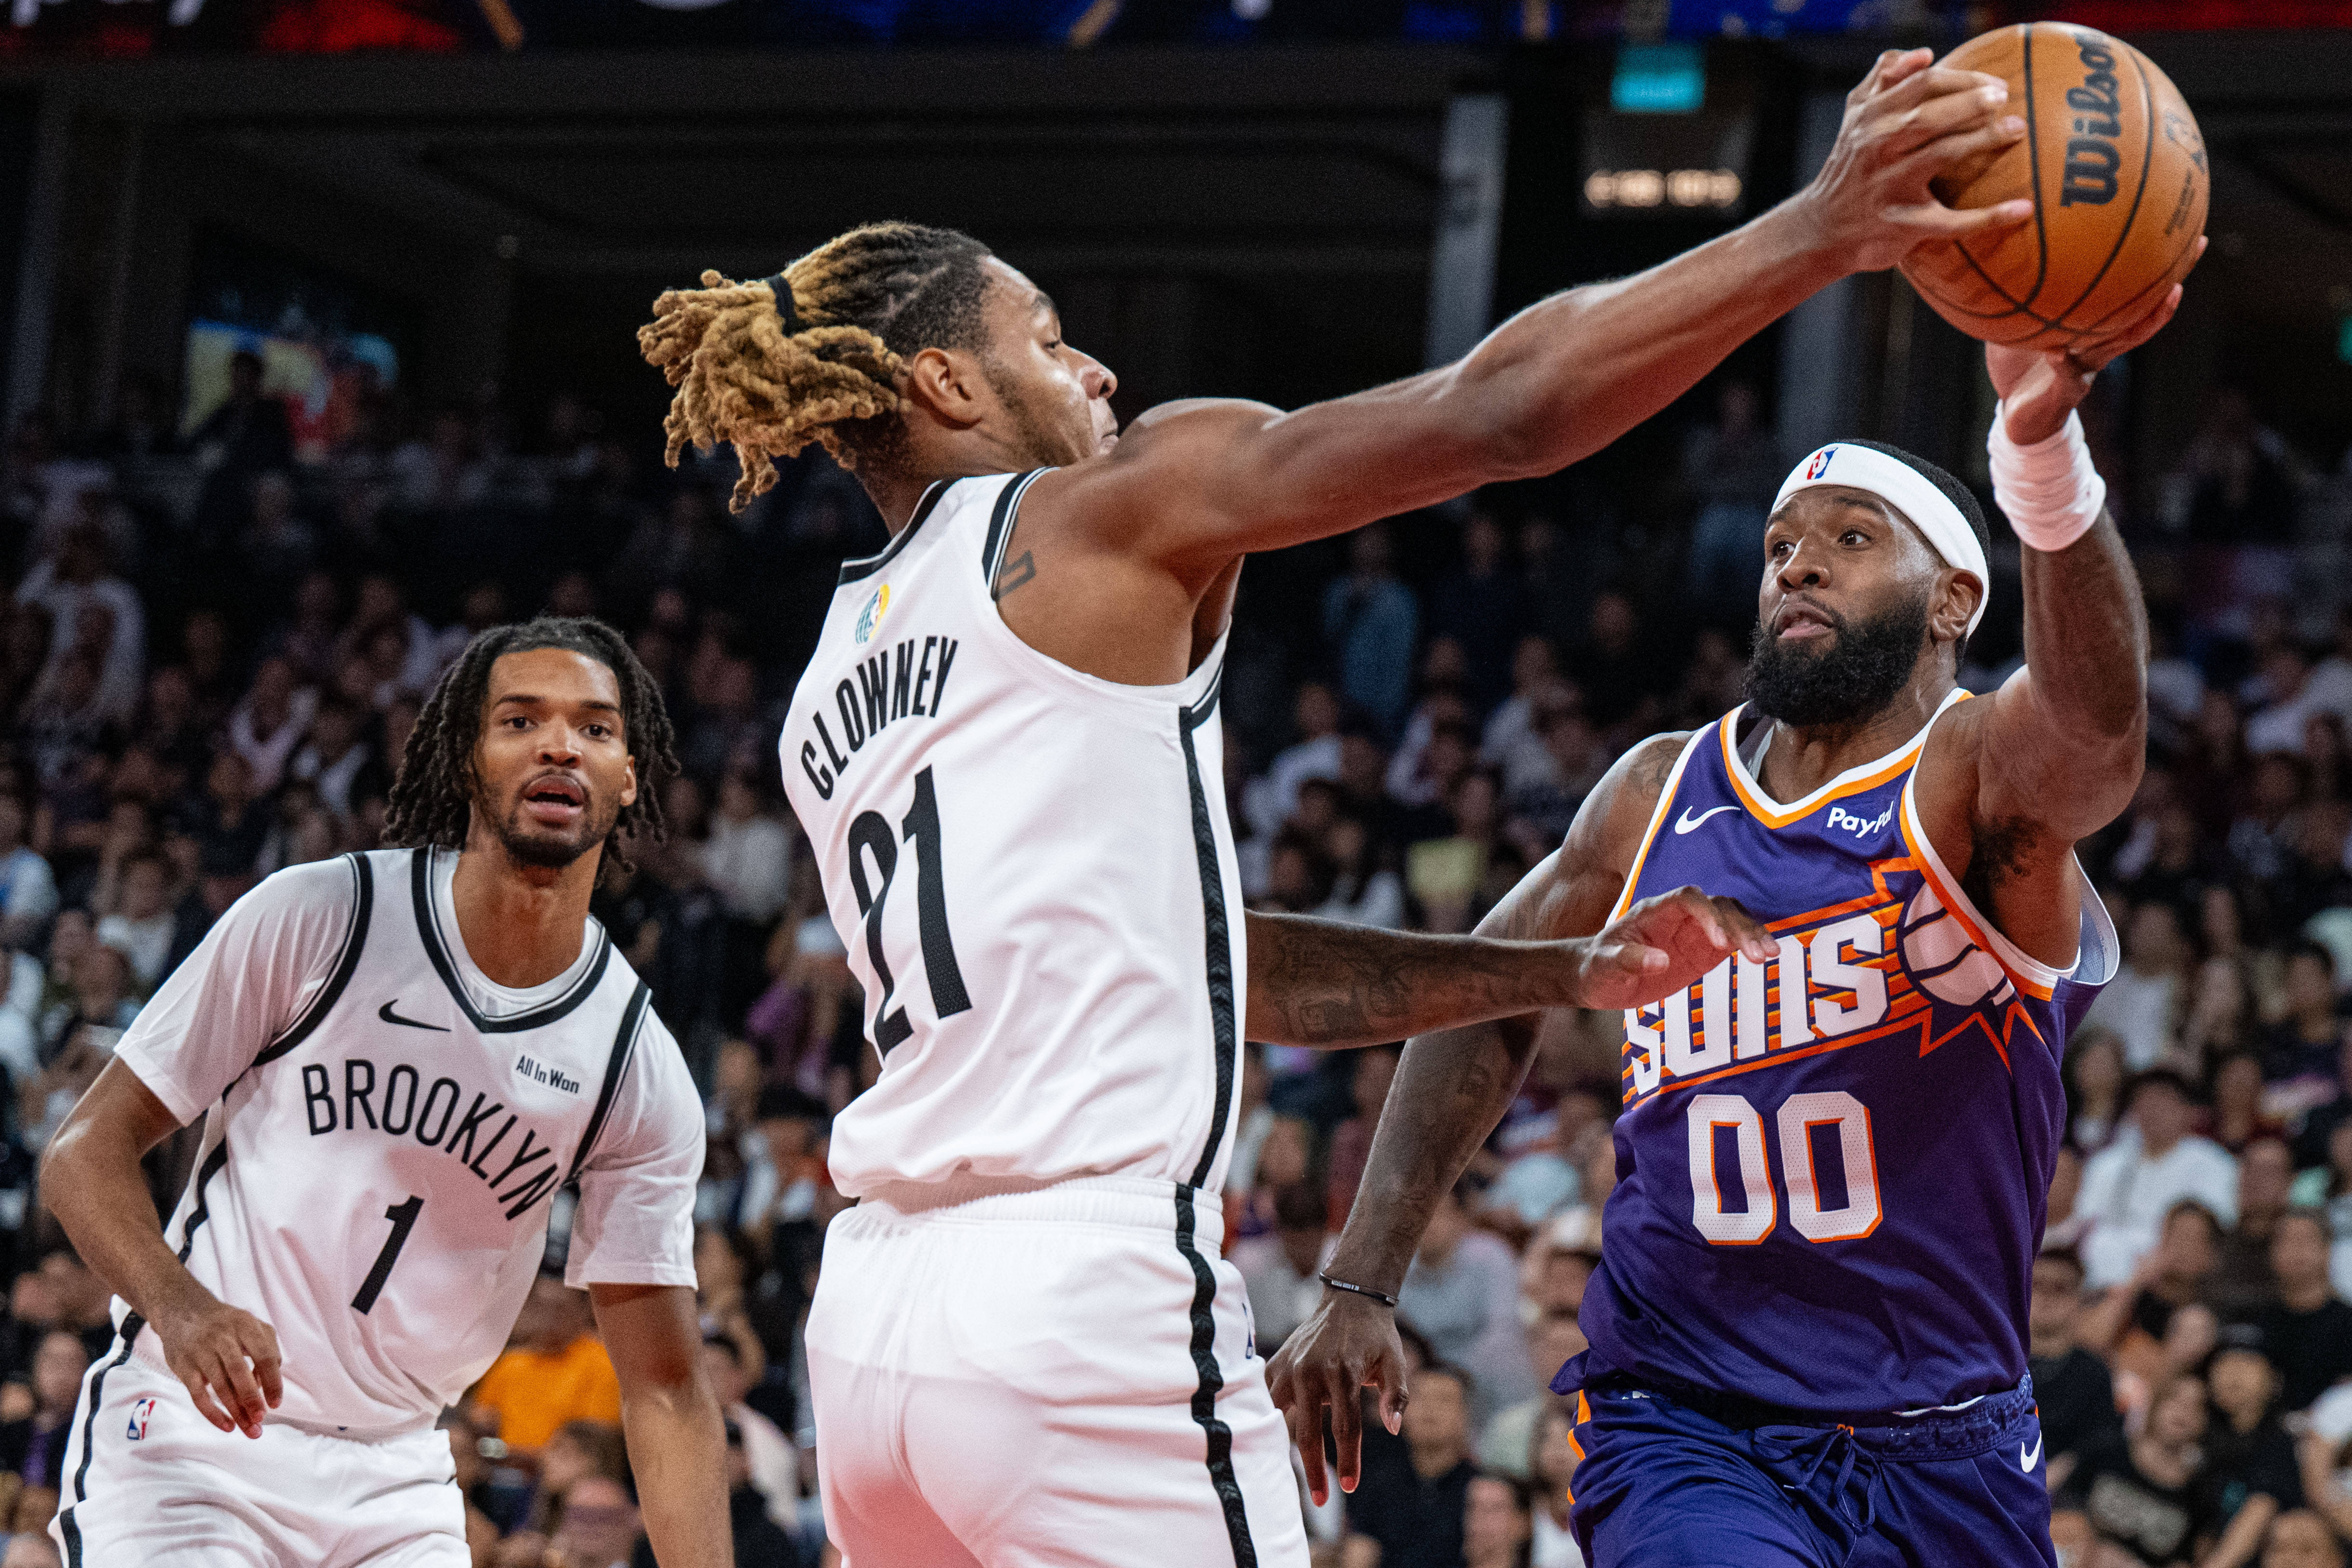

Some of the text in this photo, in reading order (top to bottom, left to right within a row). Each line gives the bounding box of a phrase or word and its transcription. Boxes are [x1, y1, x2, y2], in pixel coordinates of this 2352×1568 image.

[801, 636, 958, 800] CLOWNEY
[1827, 800, 1894, 838] PayPal
[848, 764, 972, 1061] 21
[302, 1059, 559, 1221] BROOKLYN
[516, 1055, 580, 1093] All In Won
[1687, 1091, 1882, 1245] 00
[351, 1195, 424, 1315] 1
